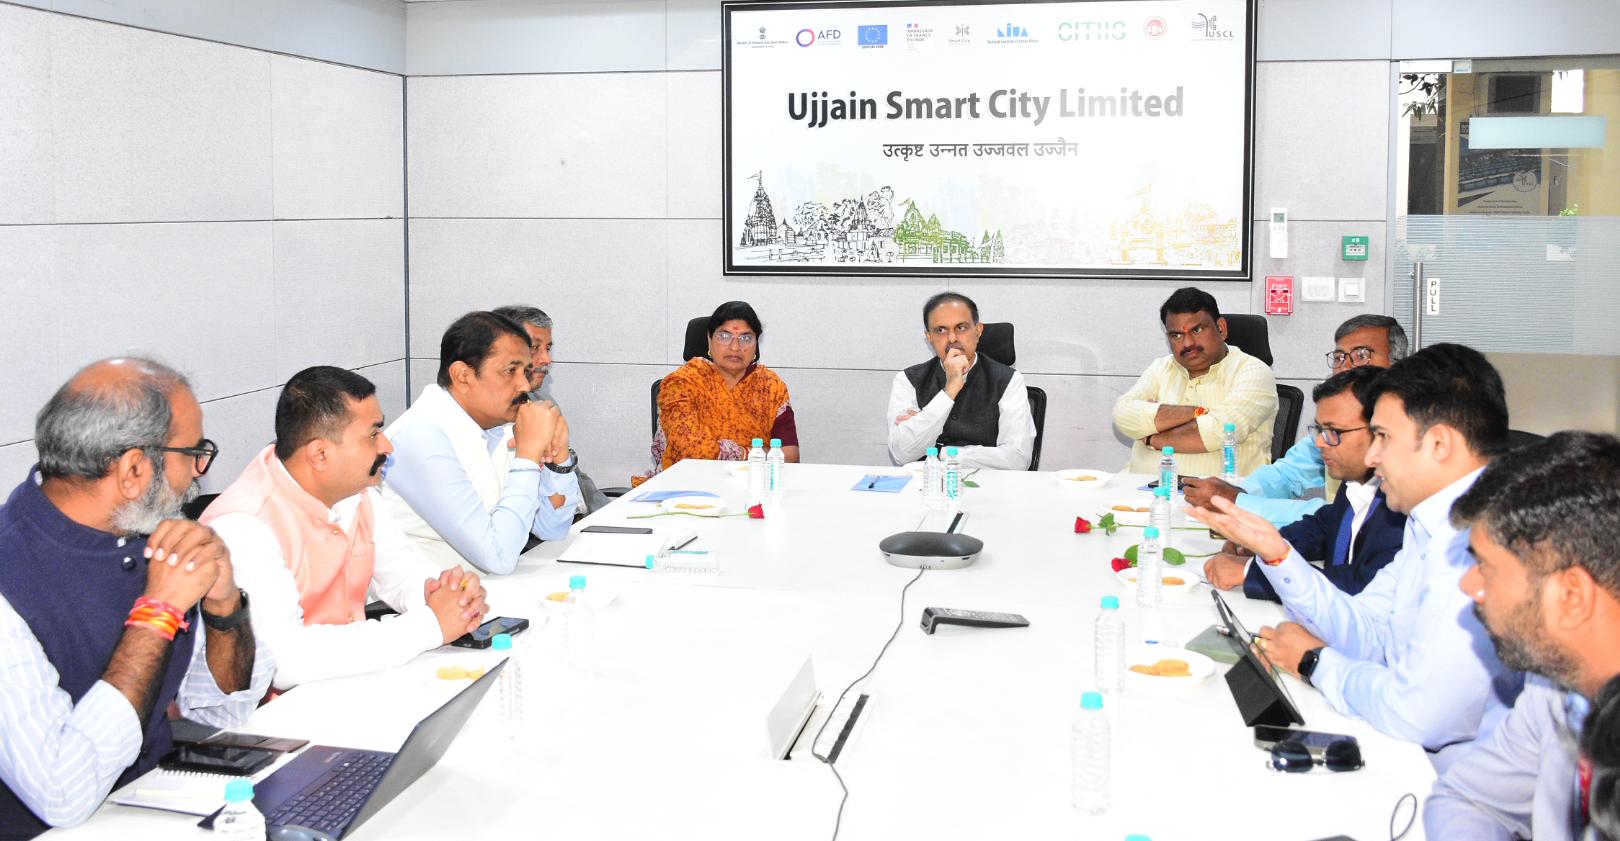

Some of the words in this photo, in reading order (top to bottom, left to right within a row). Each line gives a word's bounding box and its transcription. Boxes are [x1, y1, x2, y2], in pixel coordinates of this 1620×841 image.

[818, 29, 841, 40] AFD
[1057, 20, 1126, 42] CITIIS
[1208, 30, 1235, 38] USCL
[788, 91, 877, 128] Ujjain
[886, 91, 980, 119] Smart
[988, 89, 1051, 127] City
[1059, 86, 1184, 118] Limited
[882, 143, 925, 162] उत्कृष्ट
[929, 143, 969, 158] उन्नत
[973, 142, 1030, 158] उज्जवल
[1033, 137, 1079, 157] उज्जैन
